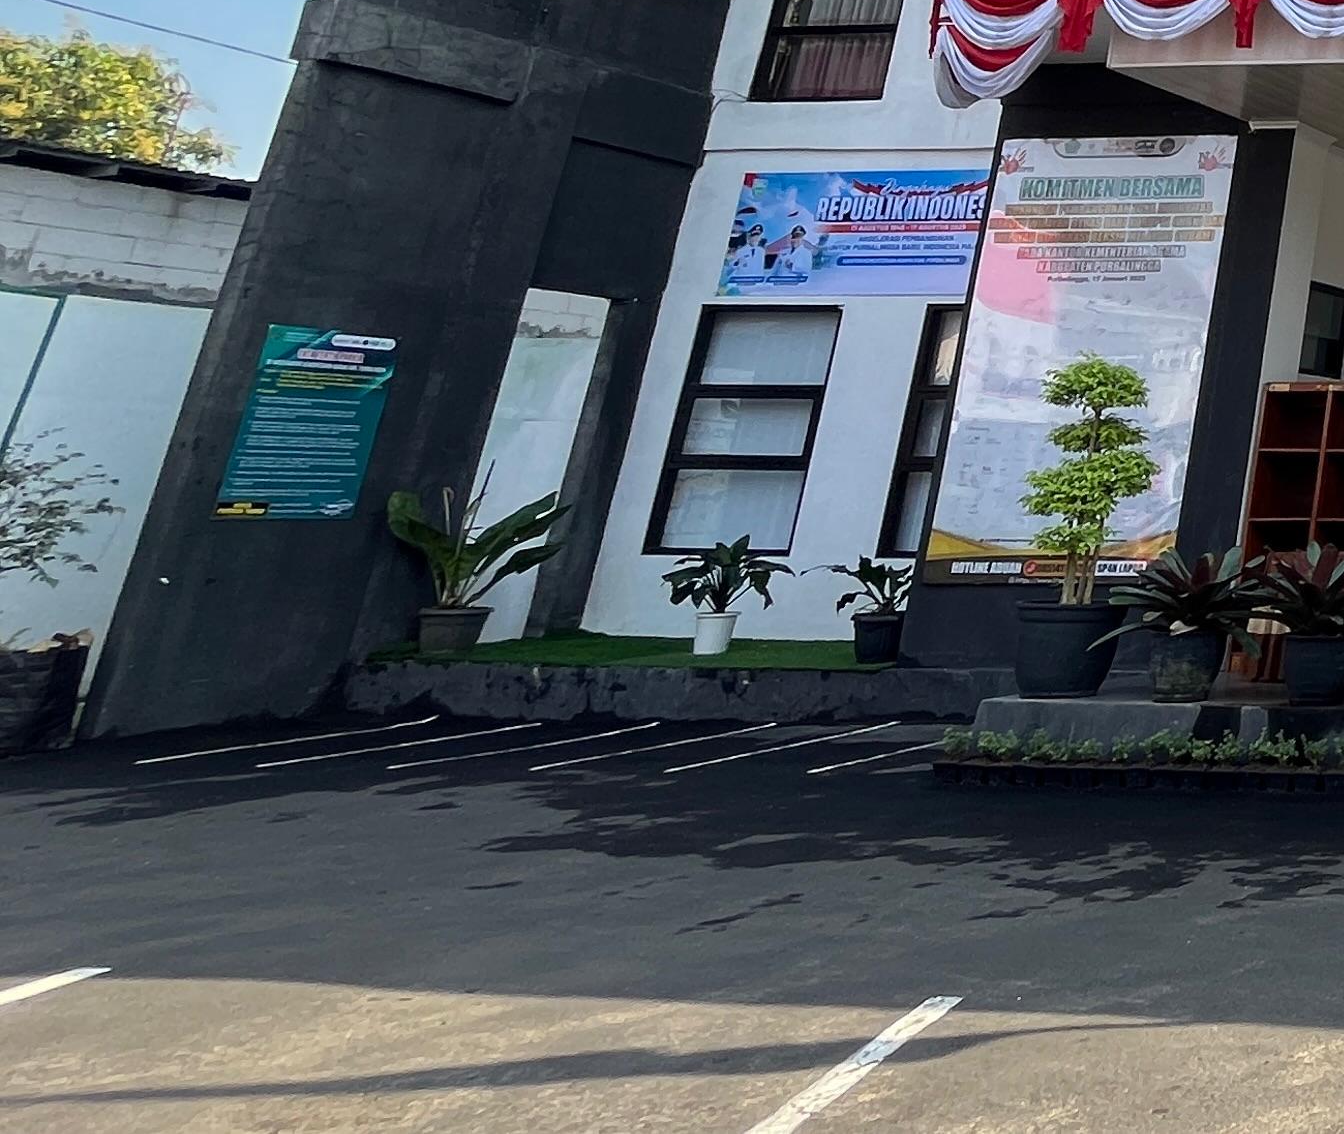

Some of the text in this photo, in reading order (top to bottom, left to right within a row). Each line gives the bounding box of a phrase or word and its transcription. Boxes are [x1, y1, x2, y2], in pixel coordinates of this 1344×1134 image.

[1020, 175, 1203, 199] KOMITMEN BERSAMA
[816, 195, 905, 221] REPUBLIK
[1093, 259, 1162, 272] PURBALINGGA
